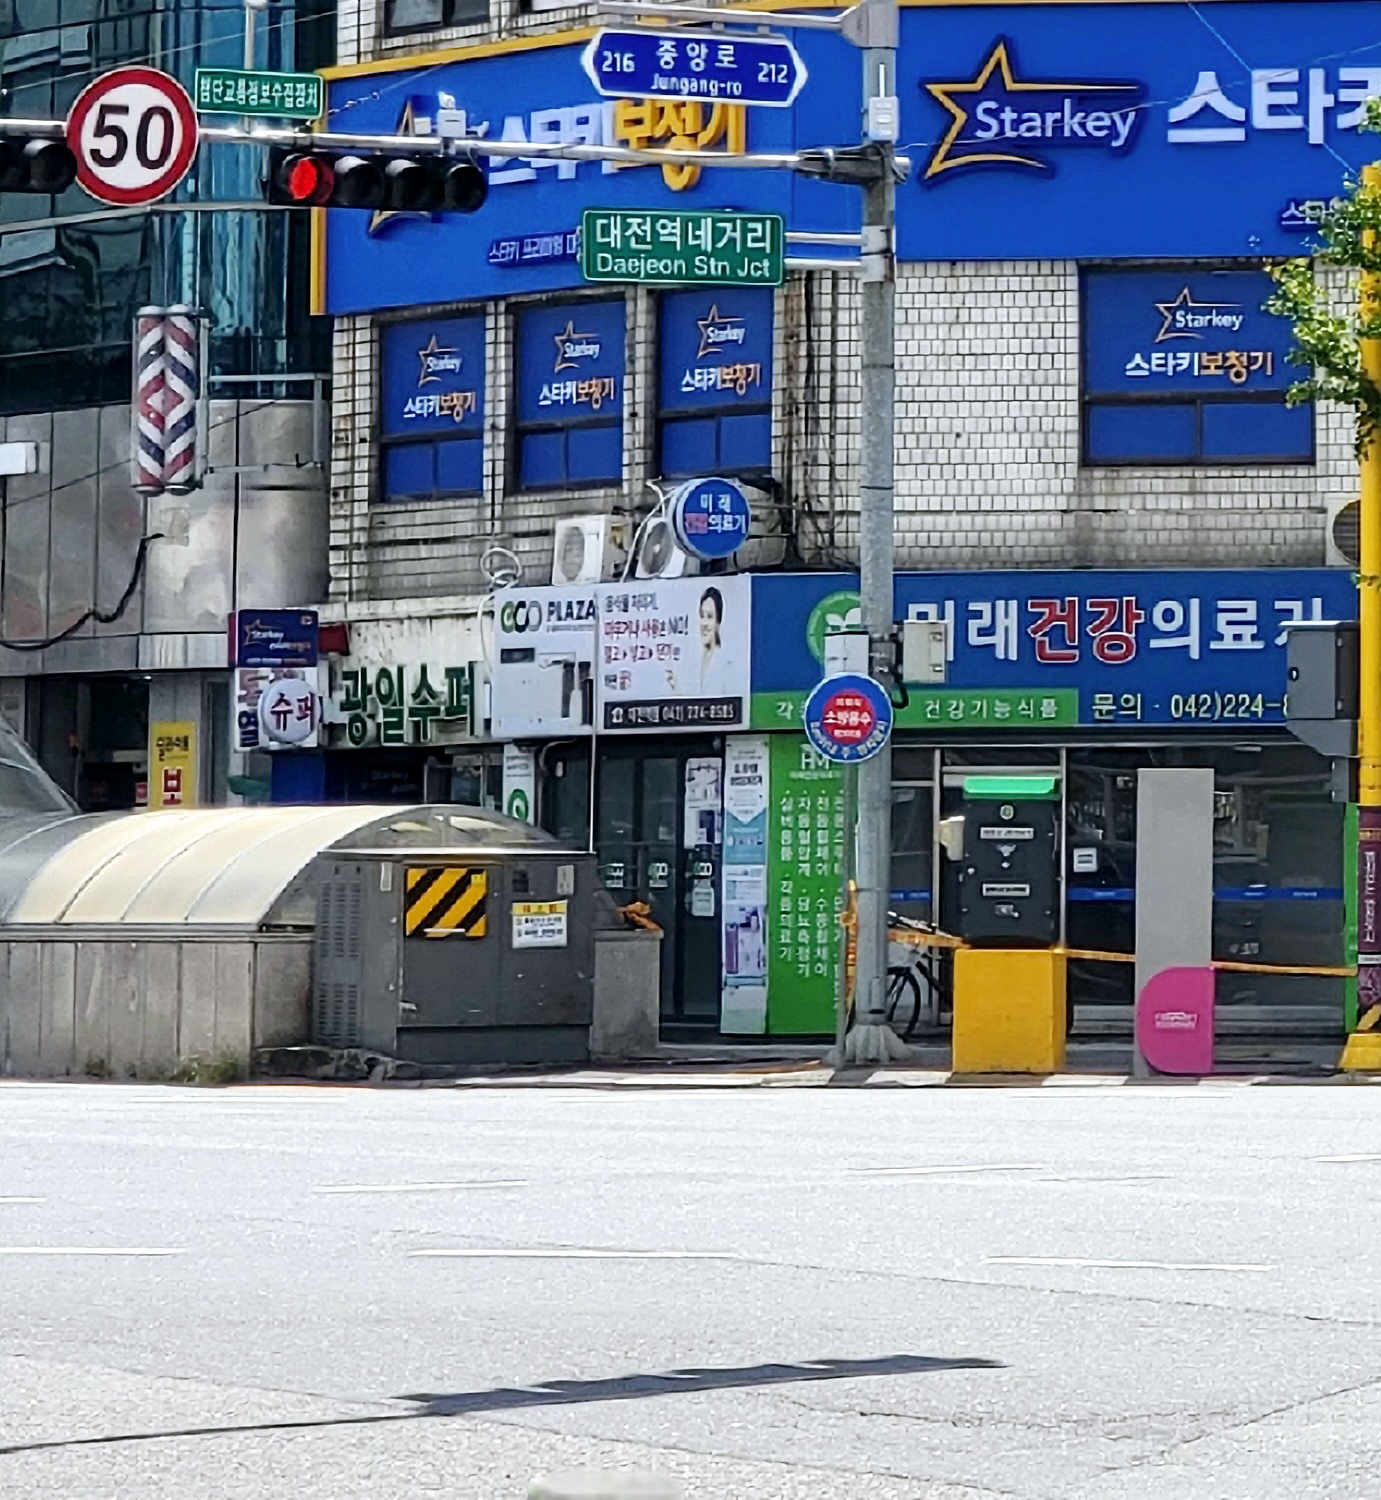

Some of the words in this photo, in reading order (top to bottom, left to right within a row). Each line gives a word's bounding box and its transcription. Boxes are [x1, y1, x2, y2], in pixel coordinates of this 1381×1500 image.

[601, 49, 635, 74] 216
[655, 38, 739, 71] 중앙로
[650, 72, 743, 96] Jungang-ro
[757, 61, 789, 84] 212
[88, 104, 175, 169] 50
[974, 98, 1136, 148] Starkey
[596, 214, 772, 254] 대전역네거리
[597, 252, 687, 278] Daejeon
[694, 257, 730, 276] Stn
[736, 257, 771, 277] Jct
[1175, 308, 1244, 332] Starkey
[1124, 350, 1274, 384] 스타키보청기
[339, 660, 476, 745] 광일수퍼
[924, 694, 1058, 721] 건강기능식품
[1090, 693, 1142, 720] 문의
